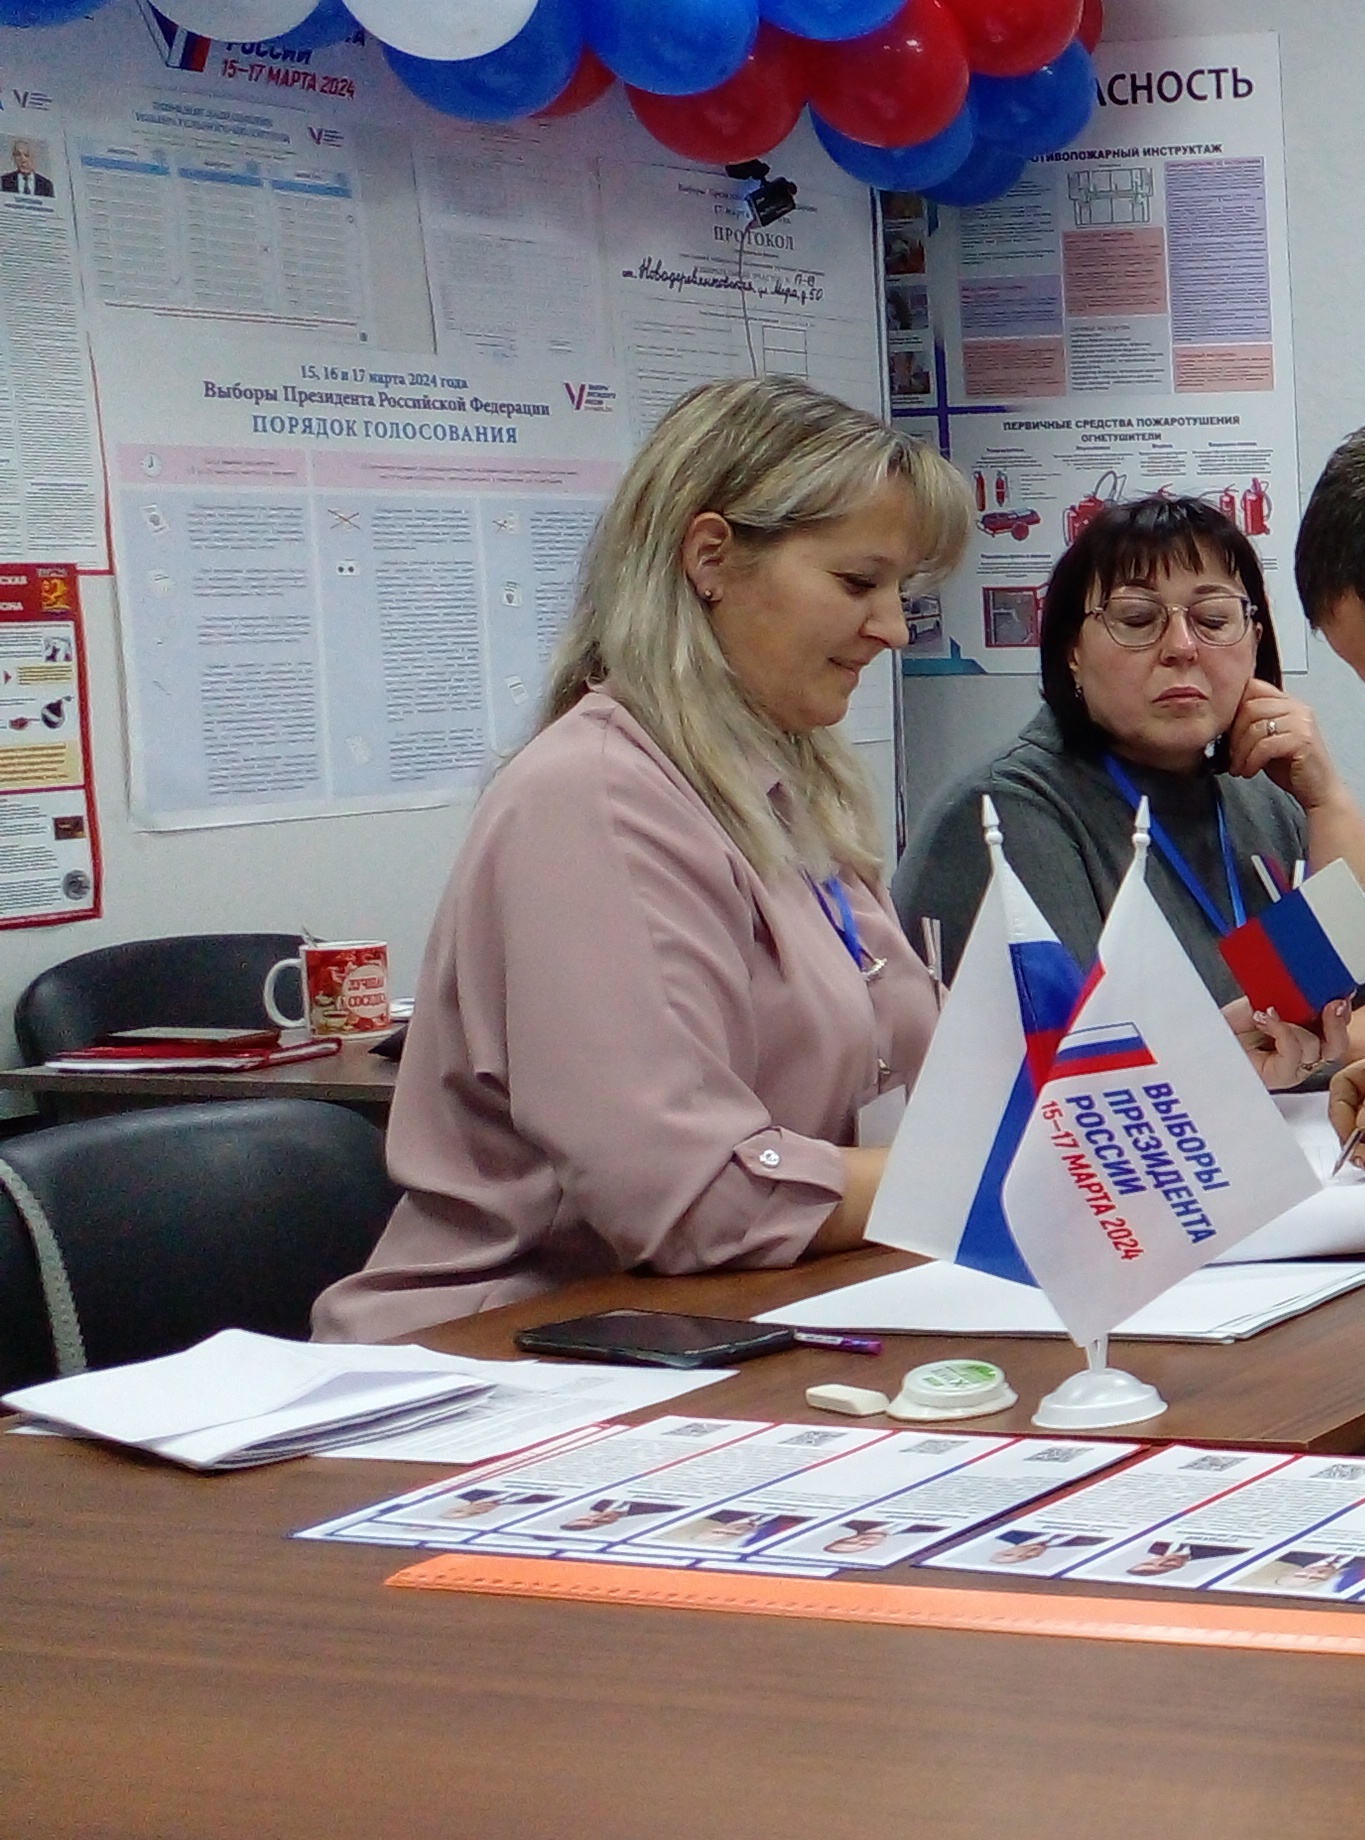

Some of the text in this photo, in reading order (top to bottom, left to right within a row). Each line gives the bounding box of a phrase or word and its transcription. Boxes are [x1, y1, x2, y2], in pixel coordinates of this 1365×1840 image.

[268, 66, 317, 92] МАРТА
[320, 76, 355, 100] 2024
[1143, 143, 1223, 157] ИНСТРУКТАЖ
[713, 226, 795, 250] ПРОТОКОЛ
[324, 366, 339, 381] 16
[352, 367, 366, 383] 17
[369, 371, 405, 390] марта
[409, 371, 438, 388] 2024
[441, 376, 469, 391] года
[203, 381, 550, 420] Выборы Президента Российской Федерации
[252, 415, 518, 444] ПОРЯДОК ГОЛОСОВАНИЯ
[1003, 415, 1240, 431] ПЕРВИЧНЫЕ СРЕДСТВА ПОЖАРОТУШЕНИЯ
[1081, 431, 1162, 443] ОГНЕТУШИТЕЛИ
[1064, 1094, 1149, 1197] РОССИИ
[1142, 1081, 1231, 1193] ВЫБОРЫ
[1102, 1088, 1218, 1245] ПРЕЗИДЕНТА
[1061, 1152, 1117, 1217] МАРТА
[1099, 1215, 1145, 1262] 2024
